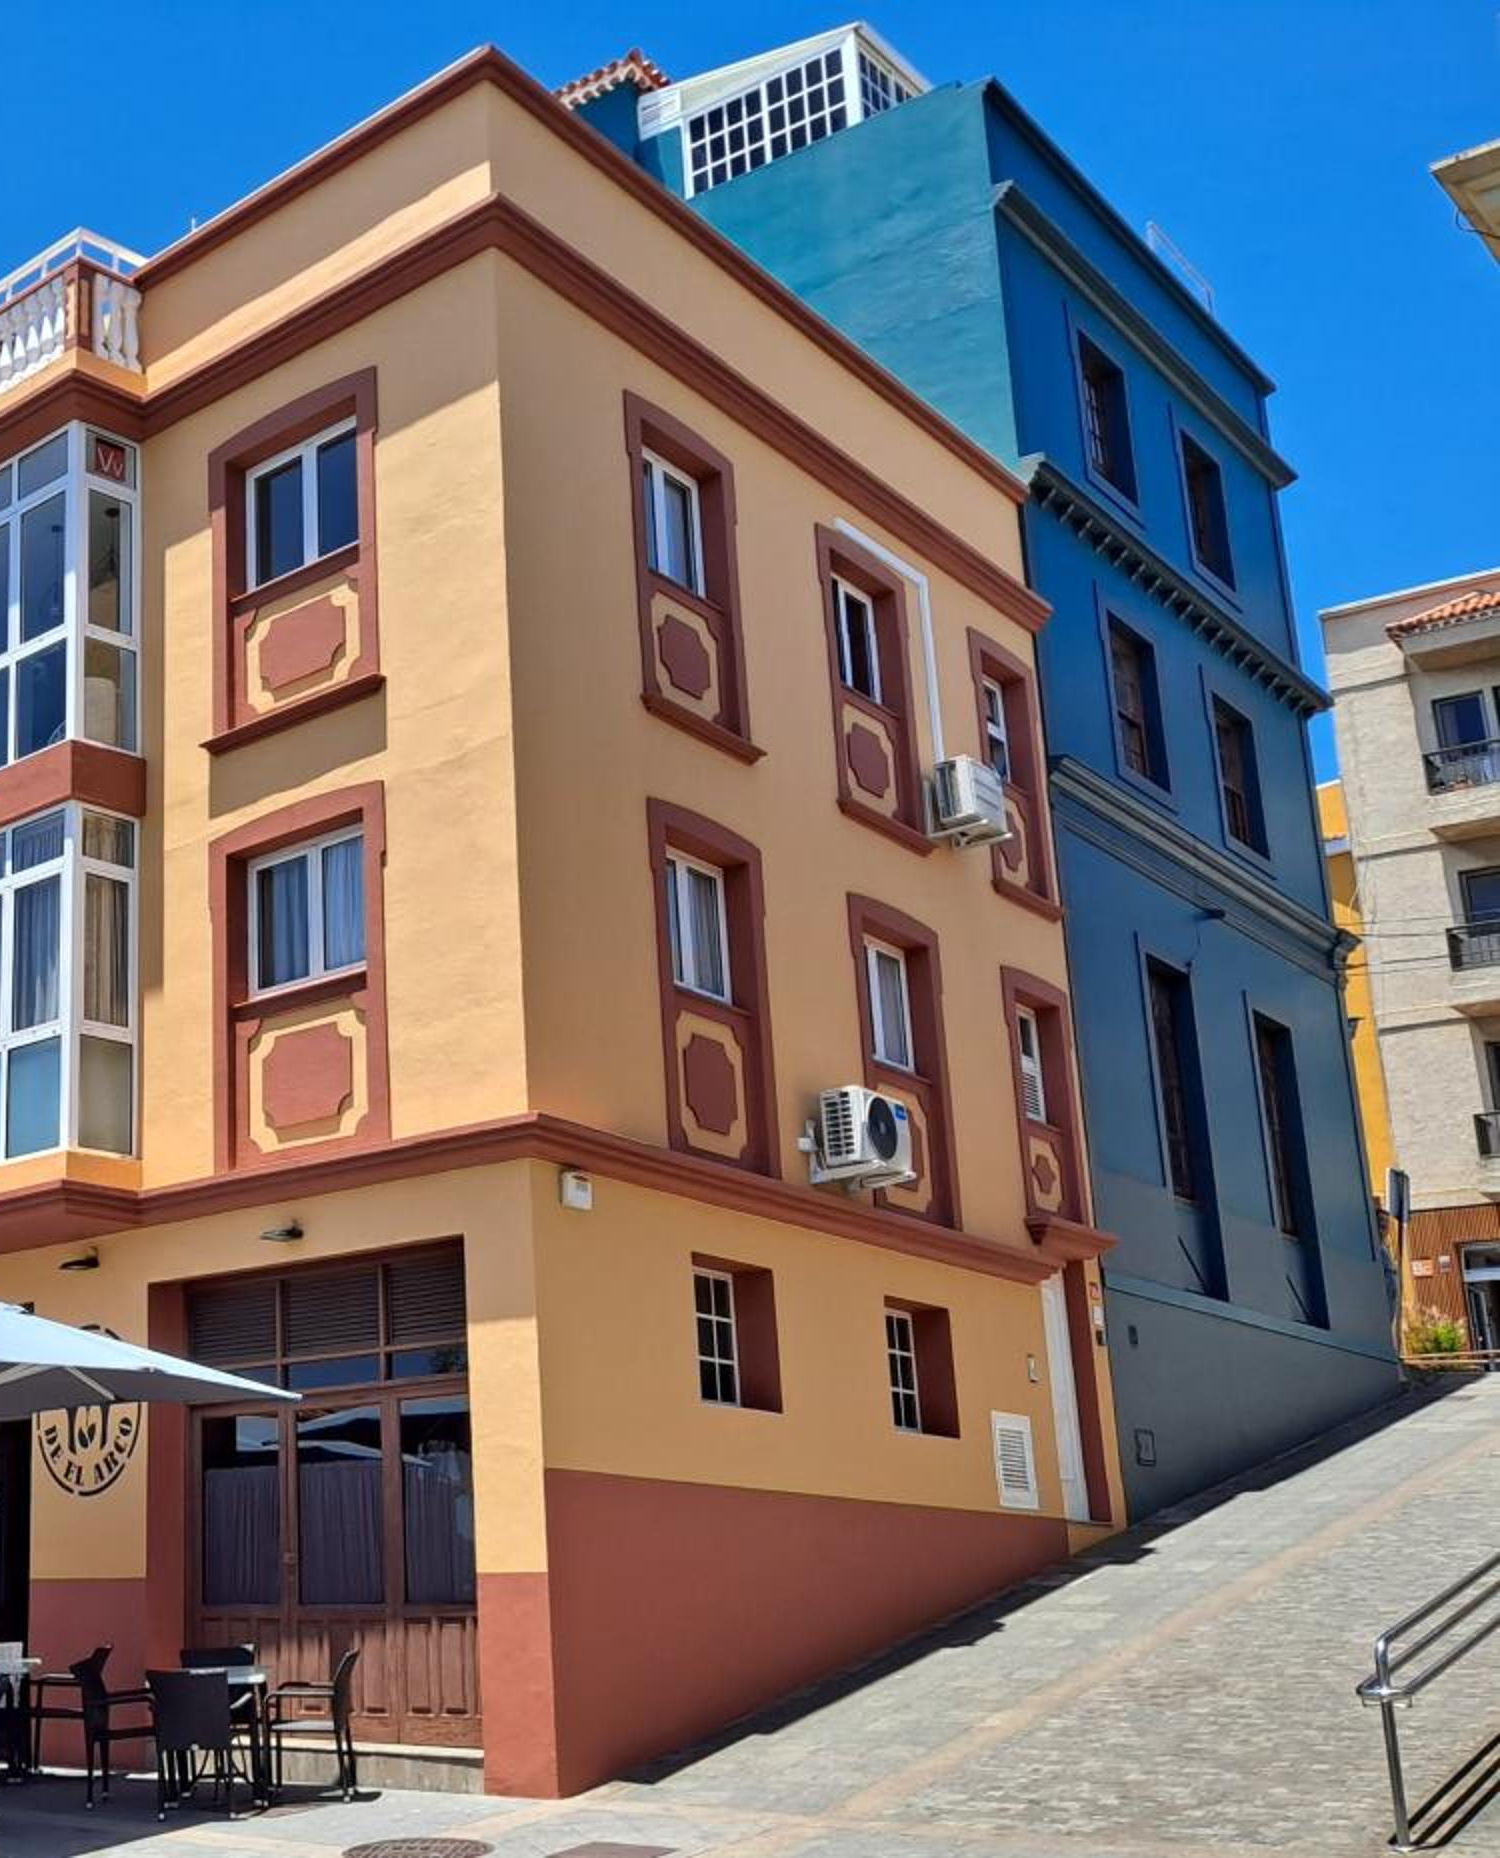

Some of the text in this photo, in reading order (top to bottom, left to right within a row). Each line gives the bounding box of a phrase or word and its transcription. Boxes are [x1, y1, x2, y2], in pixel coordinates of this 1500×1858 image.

[45, 1417, 133, 1485] DE EL ARCO
